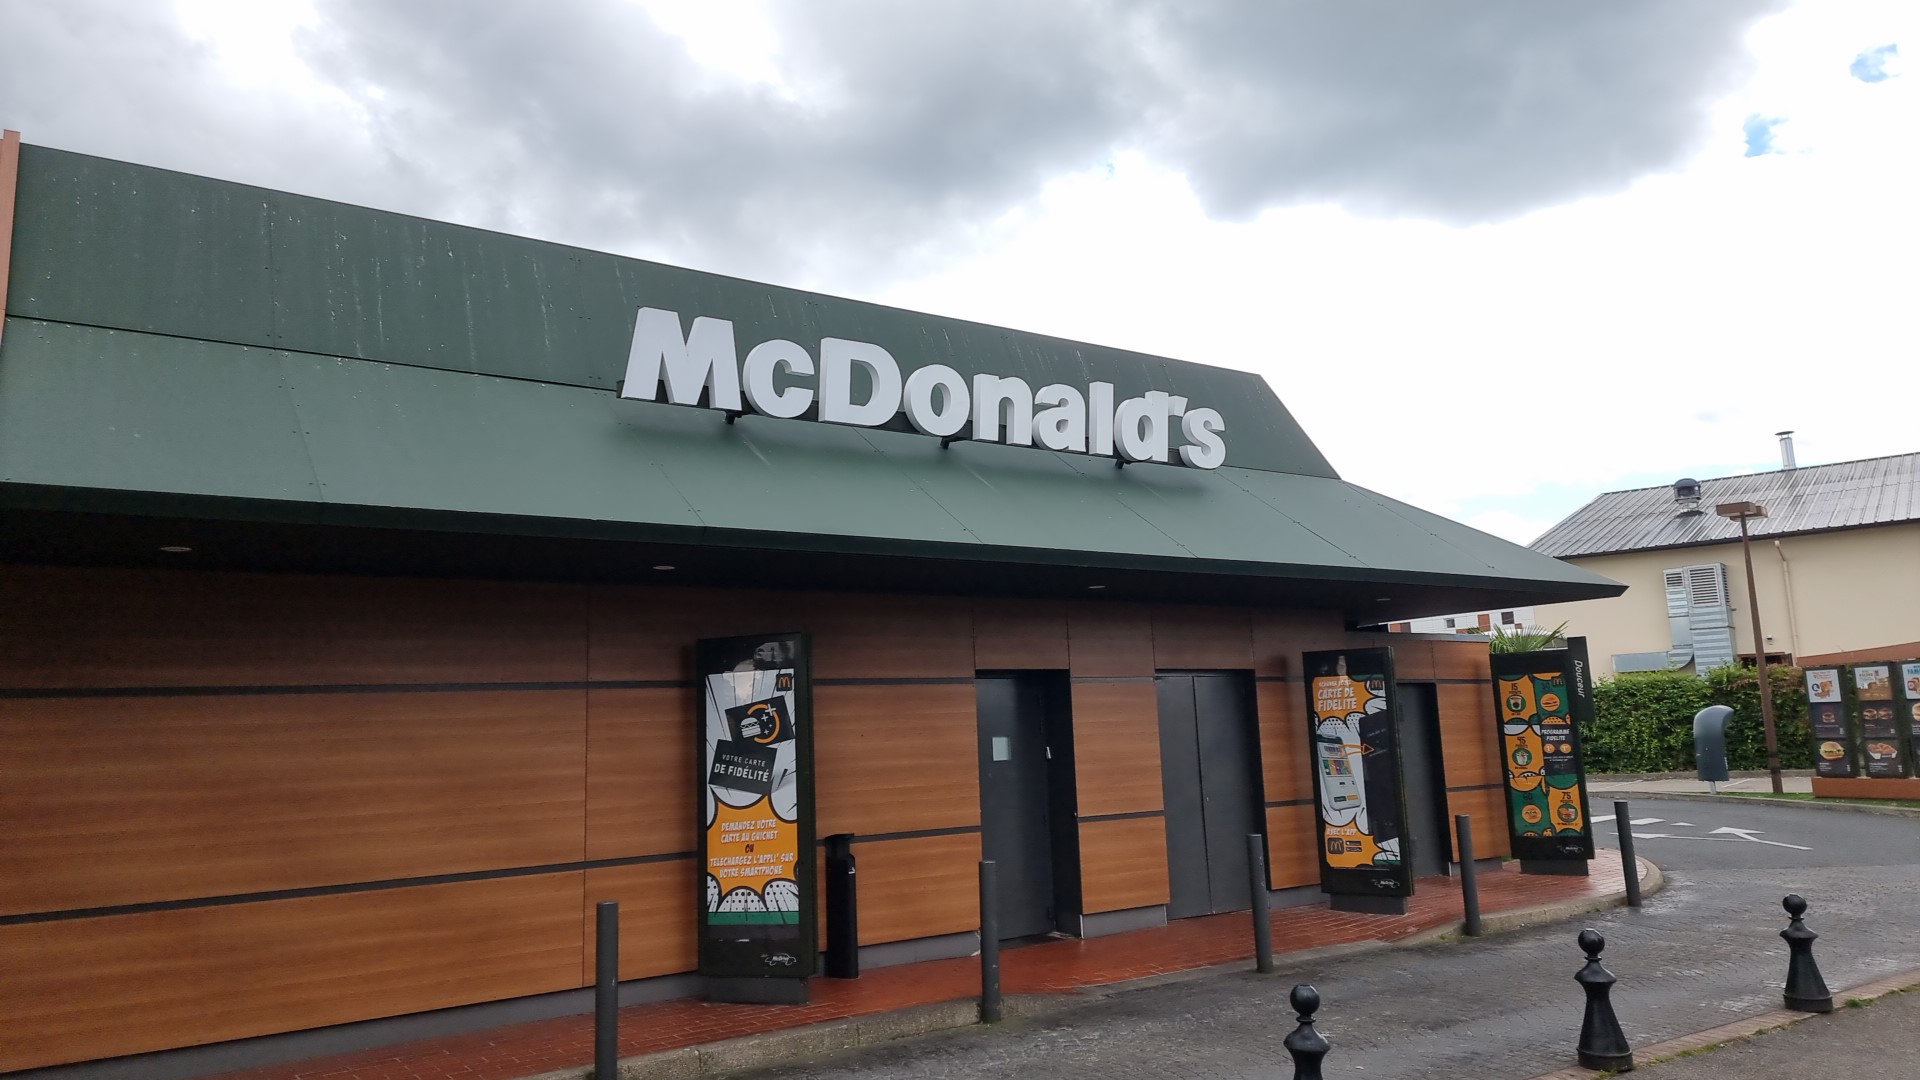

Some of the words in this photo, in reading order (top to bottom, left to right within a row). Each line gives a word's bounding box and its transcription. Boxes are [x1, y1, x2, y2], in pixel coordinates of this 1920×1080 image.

[621, 306, 1226, 470] McDonald's
[1574, 660, 1585, 698] Douceur
[1318, 687, 1342, 699] CARTE
[1344, 686, 1355, 697] DE
[1511, 683, 1519, 691] 15
[1318, 697, 1357, 711] FIDELITE
[722, 754, 742, 763] VOTRE
[744, 758, 766, 767] CARTE
[714, 763, 726, 774] DE
[727, 766, 770, 782] FIDÉLITÉ
[1561, 791, 1572, 800] 75
[721, 820, 755, 831] DEMANDEZ
[757, 818, 777, 829] VOTRE
[721, 833, 741, 843] CARTE
[741, 832, 750, 842] AU
[751, 830, 779, 841] GUICHET
[745, 843, 755, 853] OU
[780, 852, 794, 863] SUR
[719, 867, 739, 878] VOTRE
[740, 865, 783, 877] SMARTPHONE
